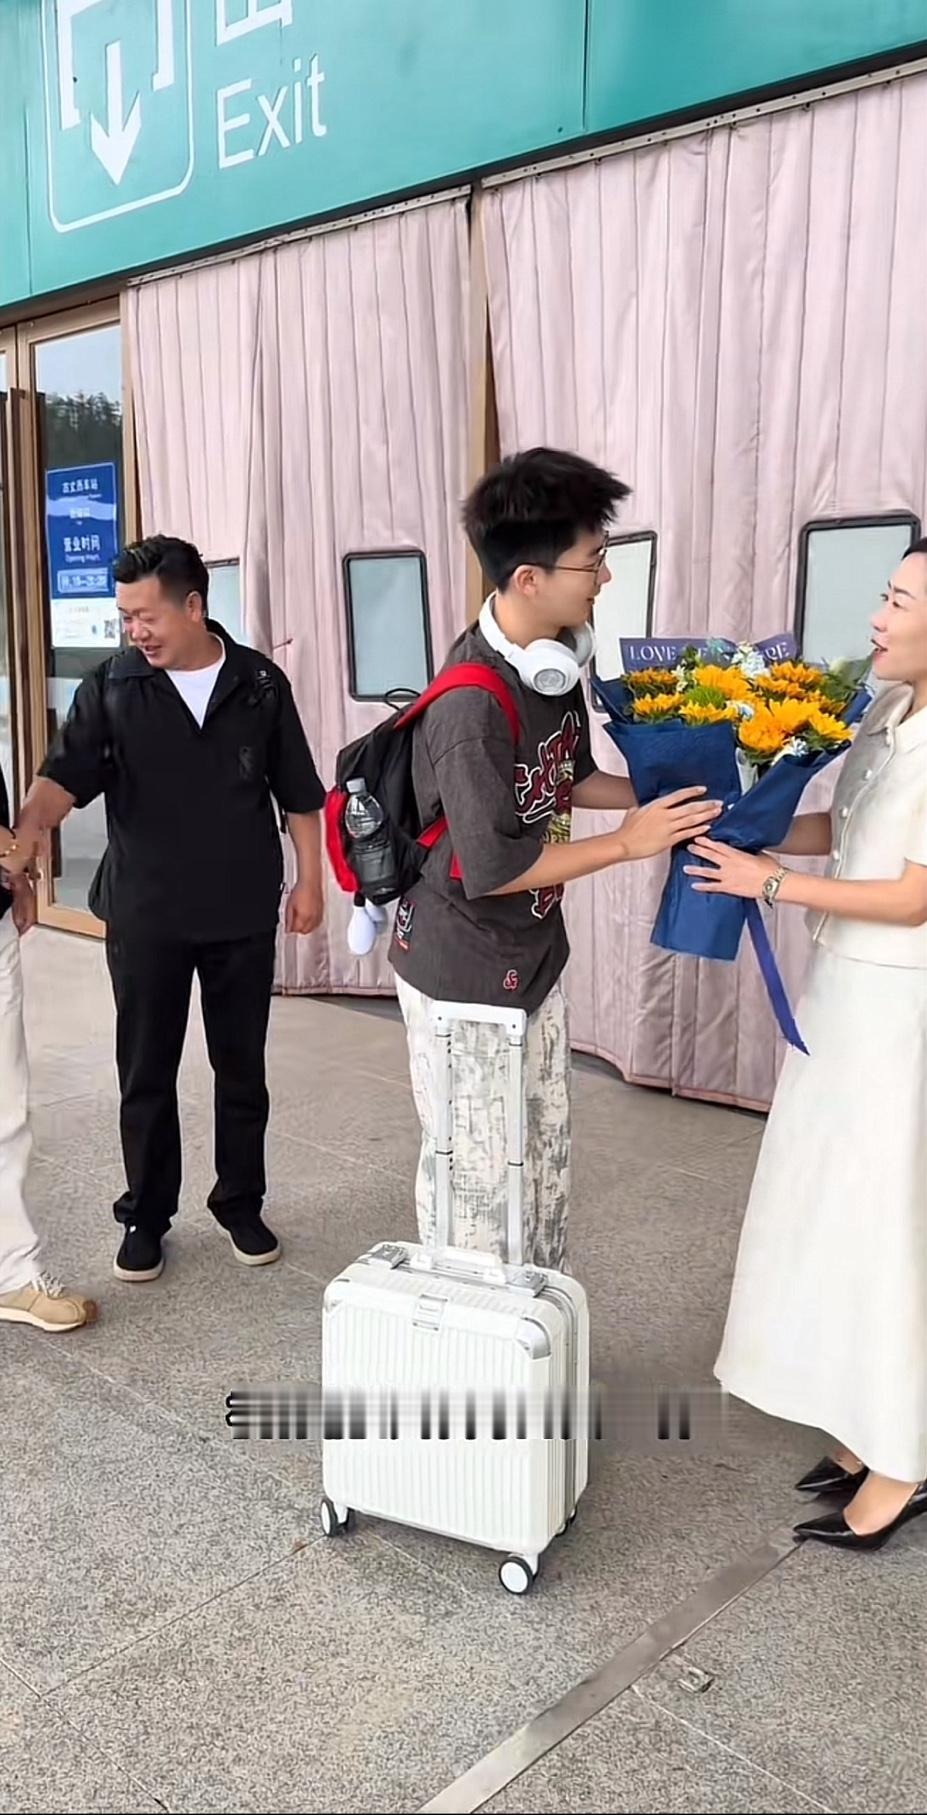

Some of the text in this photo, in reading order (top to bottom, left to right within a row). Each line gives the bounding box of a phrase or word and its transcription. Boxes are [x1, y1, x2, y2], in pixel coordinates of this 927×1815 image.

[217, 53, 327, 169] Exit
[63, 534, 101, 552] 营业时间
[629, 645, 678, 663] LOVE
